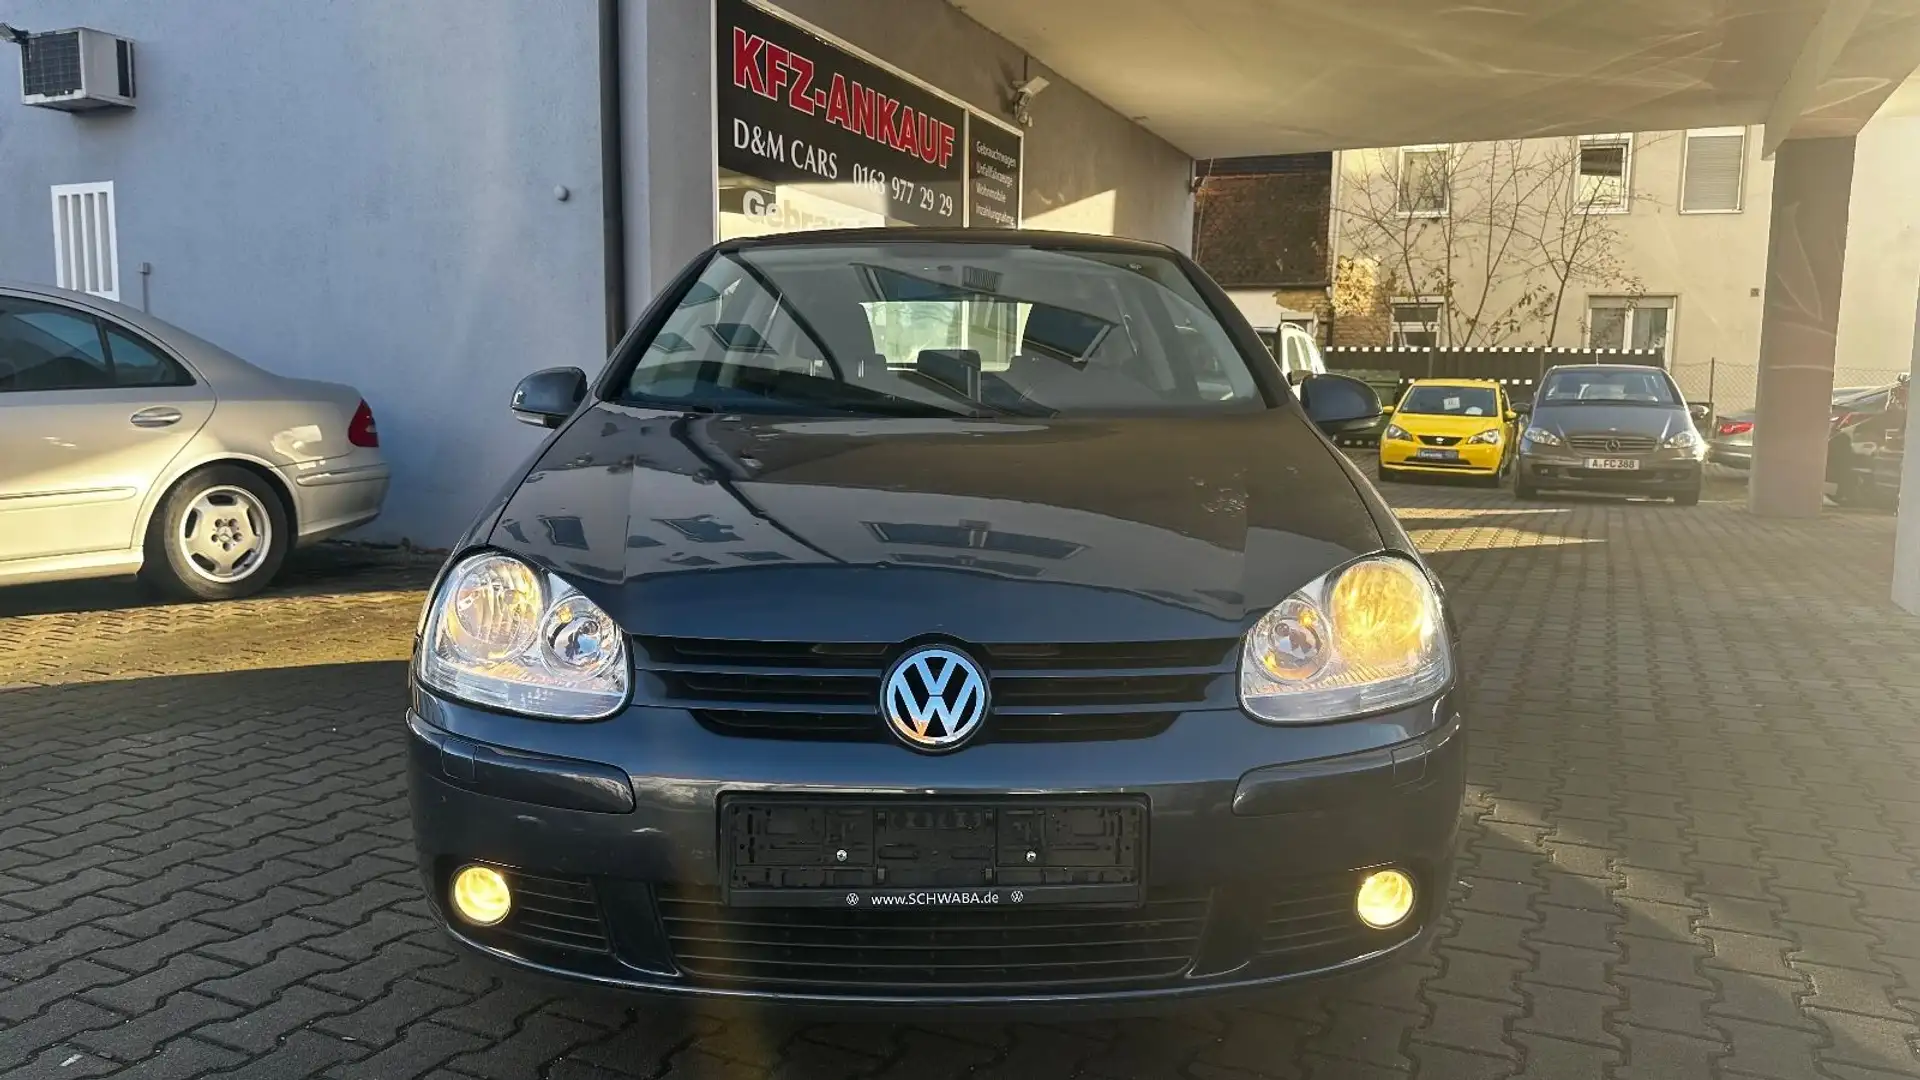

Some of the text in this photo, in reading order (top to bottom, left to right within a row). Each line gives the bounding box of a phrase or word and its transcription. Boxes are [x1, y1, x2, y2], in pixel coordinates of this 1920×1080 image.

[733, 26, 955, 169] KFZ-ANKAUF
[733, 118, 953, 217] D&M CARS 0163 977 29 29
[871, 891, 999, 905] www.SCHWABA.de
